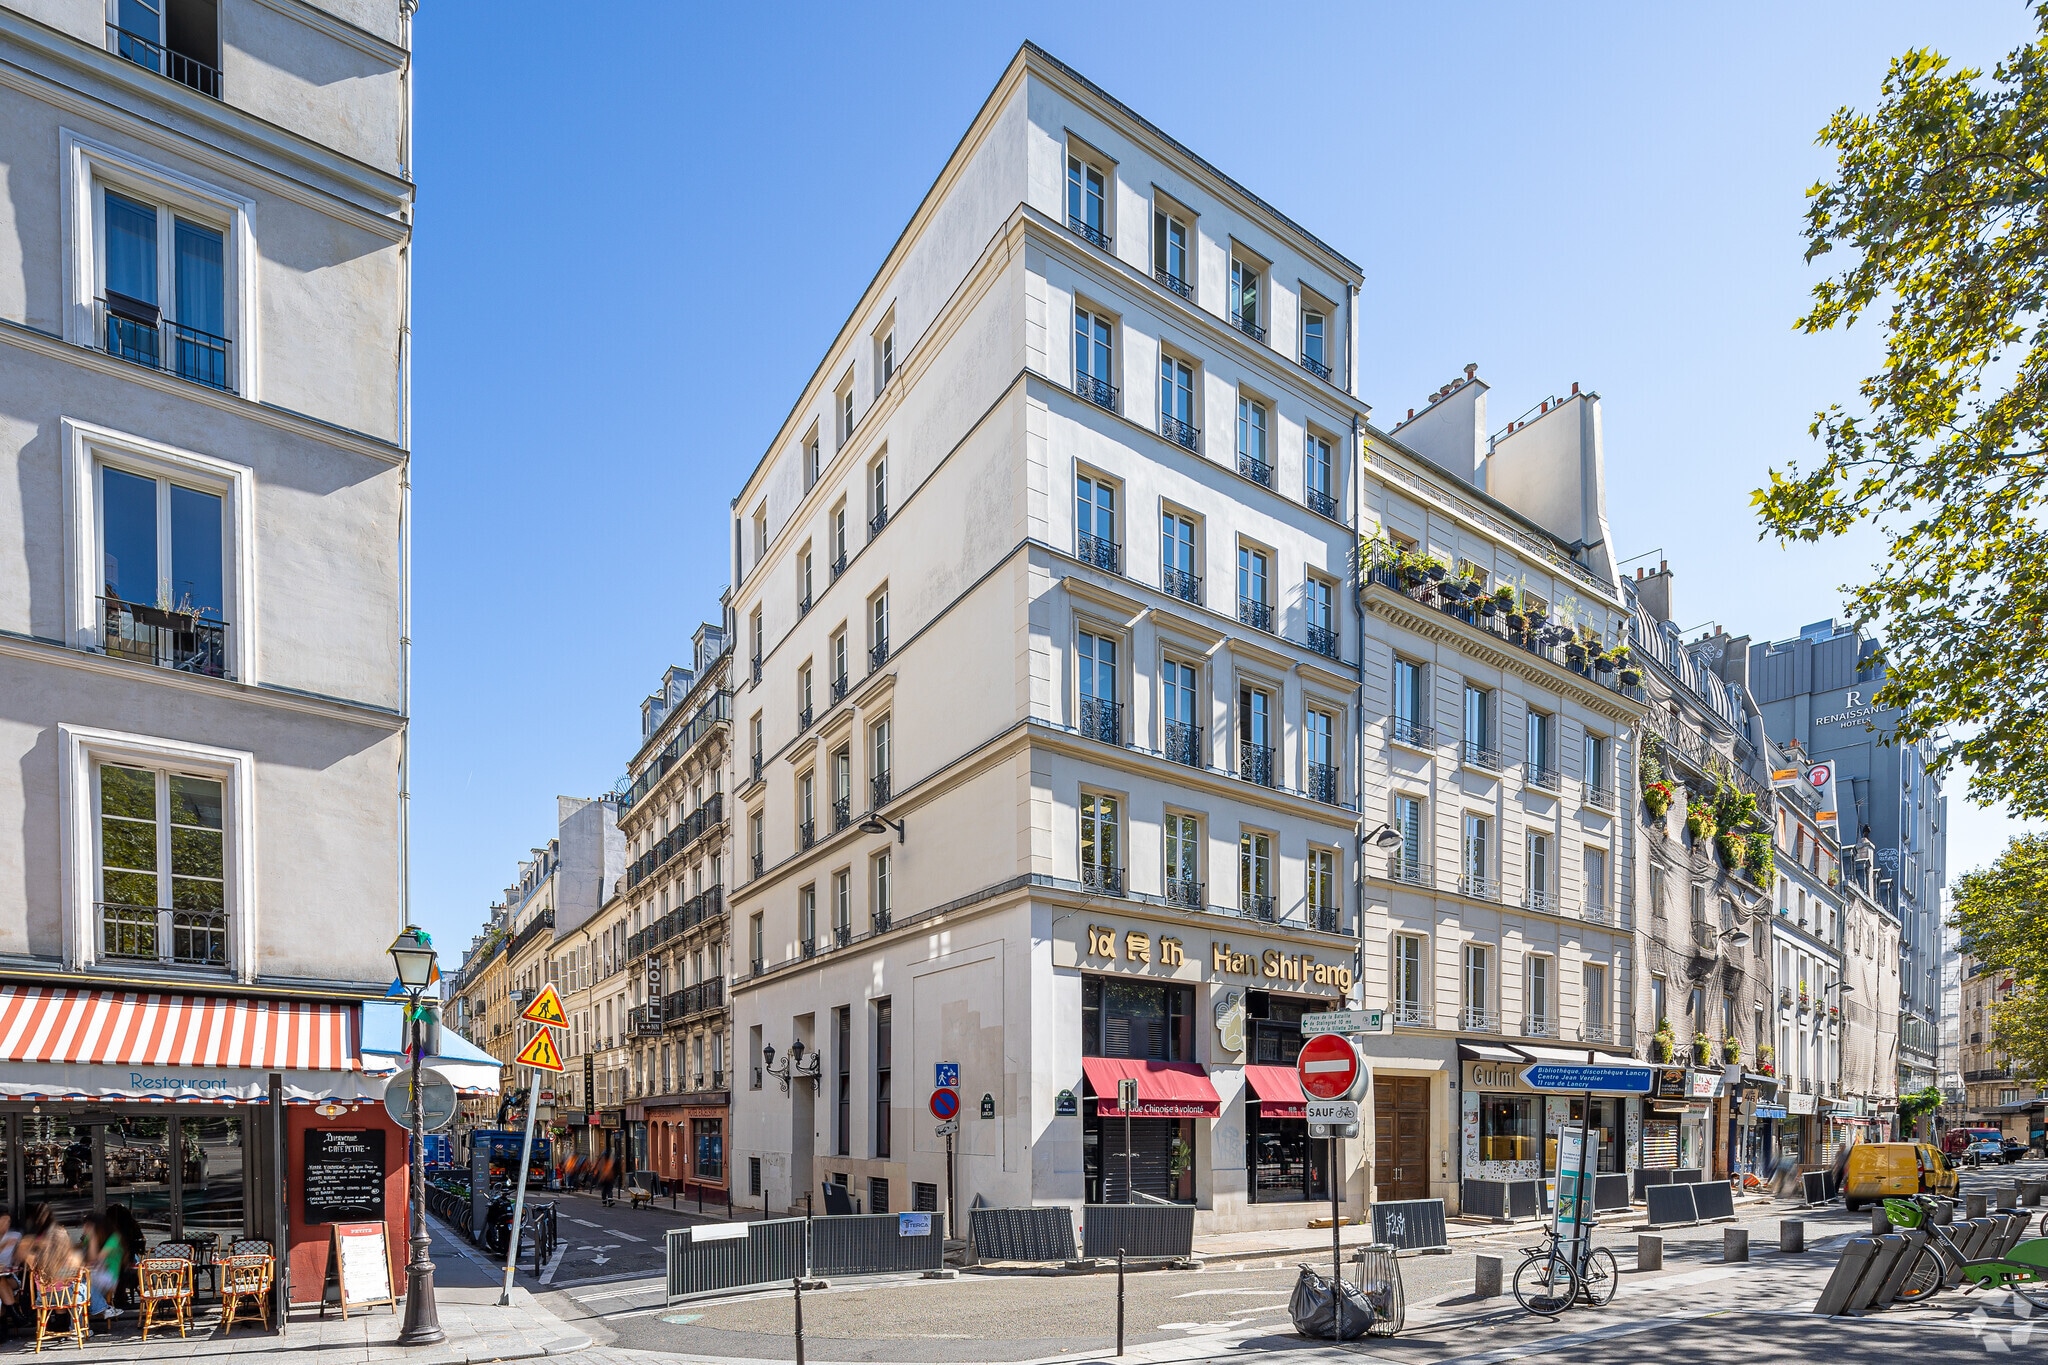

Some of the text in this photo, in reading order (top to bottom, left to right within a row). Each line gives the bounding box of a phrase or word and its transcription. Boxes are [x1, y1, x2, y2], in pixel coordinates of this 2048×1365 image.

[1845, 691, 1866, 709] R
[1212, 942, 1353, 994] Han Shi Fang
[648, 958, 661, 1018] HOTEL
[129, 1072, 228, 1090] Restaurant
[1473, 1065, 1516, 1087] Guimi
[1582, 1068, 1624, 1076] discothèque
[1144, 1104, 1174, 1113] Chinoise
[1174, 1104, 1179, 1113] à
[1180, 1105, 1204, 1114] volonté
[1309, 1107, 1335, 1117] SAUF
